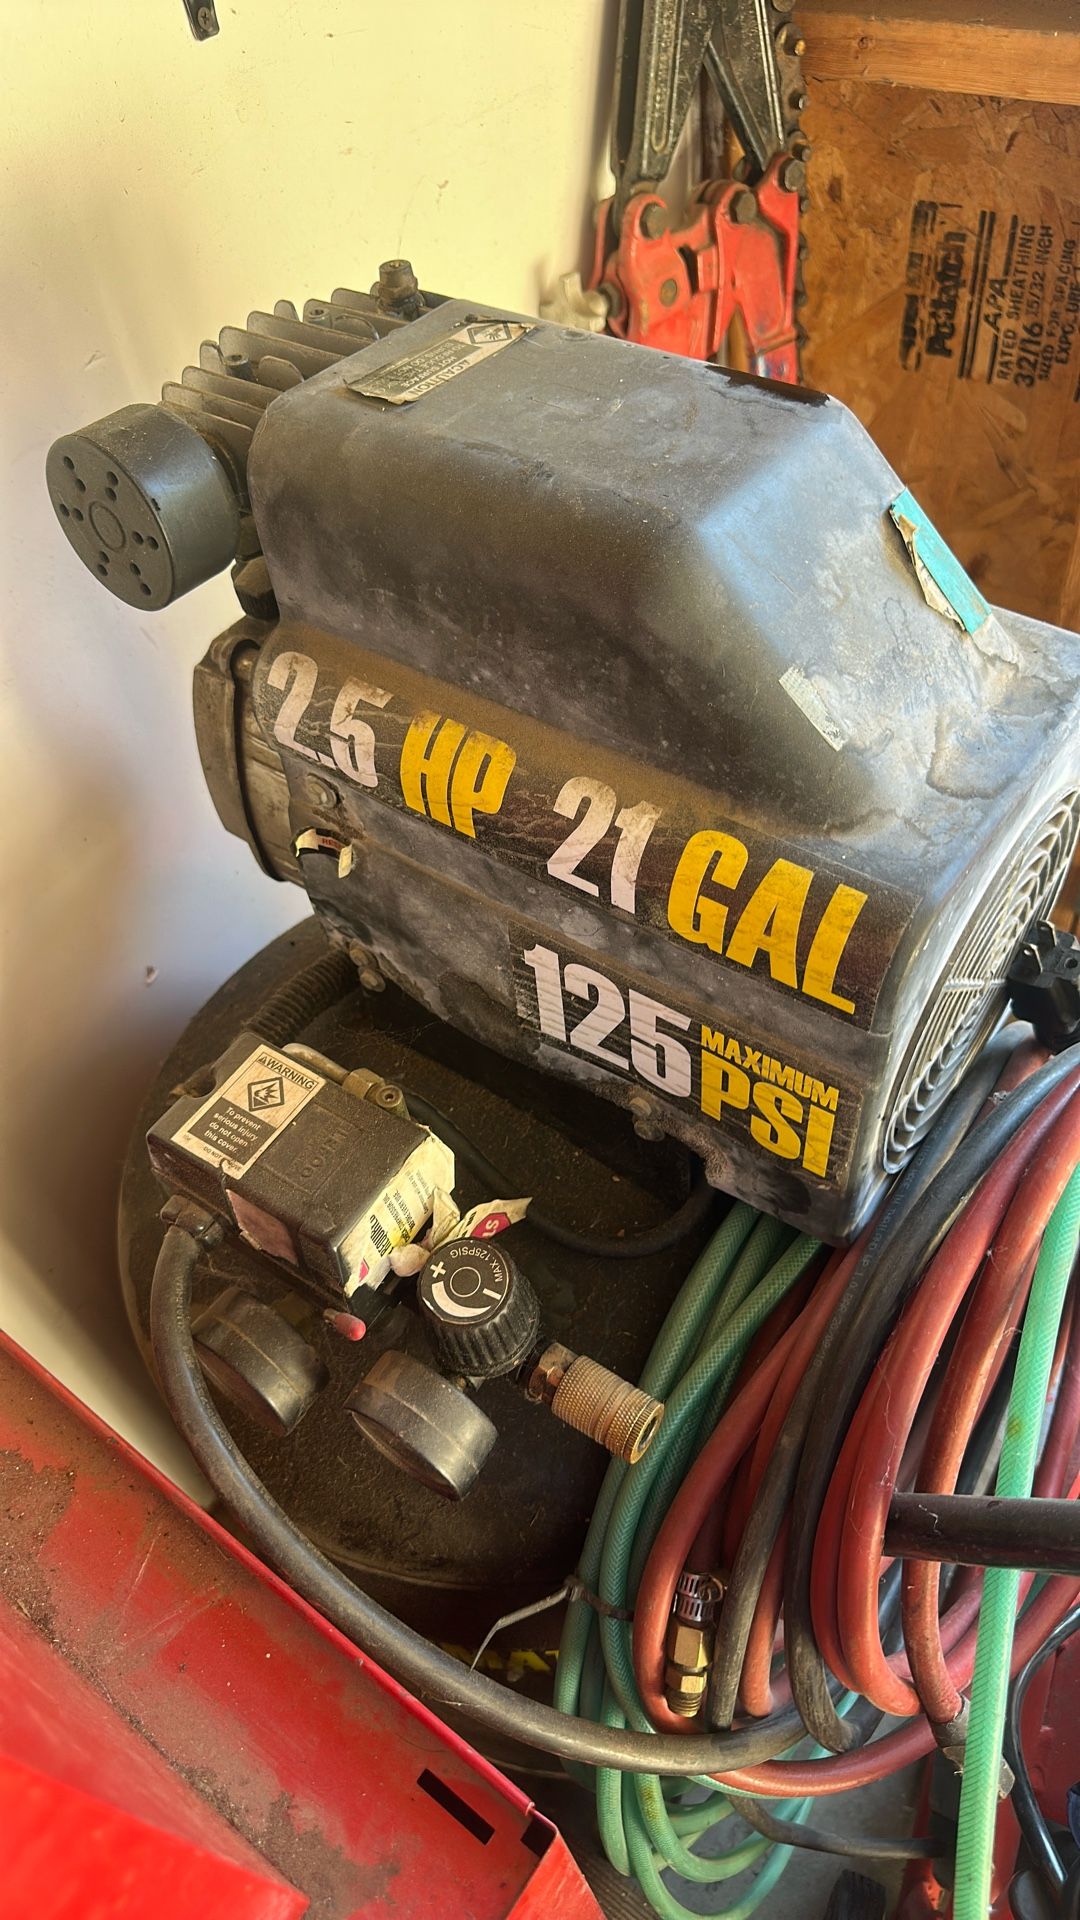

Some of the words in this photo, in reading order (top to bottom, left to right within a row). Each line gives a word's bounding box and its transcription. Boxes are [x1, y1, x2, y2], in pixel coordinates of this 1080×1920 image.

[1006, 224, 1035, 321] SHEATHING
[984, 277, 1008, 335] APA
[1056, 283, 1080, 365] EXPOURE
[408, 362, 463, 395] CAUTION
[997, 329, 1016, 380] RATED
[1013, 321, 1044, 387] 32/16
[267, 650, 395, 787] 2.5
[400, 709, 518, 839] HP
[547, 776, 663, 914] 21
[667, 830, 868, 1015] GAL
[523, 944, 692, 1098] 125
[265, 1058, 315, 1090] WARNING
[700, 1024, 840, 1110] MAXIMUM
[204, 1130, 218, 1141] this
[217, 1138, 237, 1153] cover.
[209, 1121, 219, 1130] do
[218, 1126, 231, 1138] not
[231, 1133, 248, 1147] open
[214, 1112, 238, 1129] serious
[238, 1124, 258, 1142] injury
[226, 1106, 234, 1116] To
[234, 1112, 261, 1131] prevent
[700, 1053, 836, 1178] PSI
